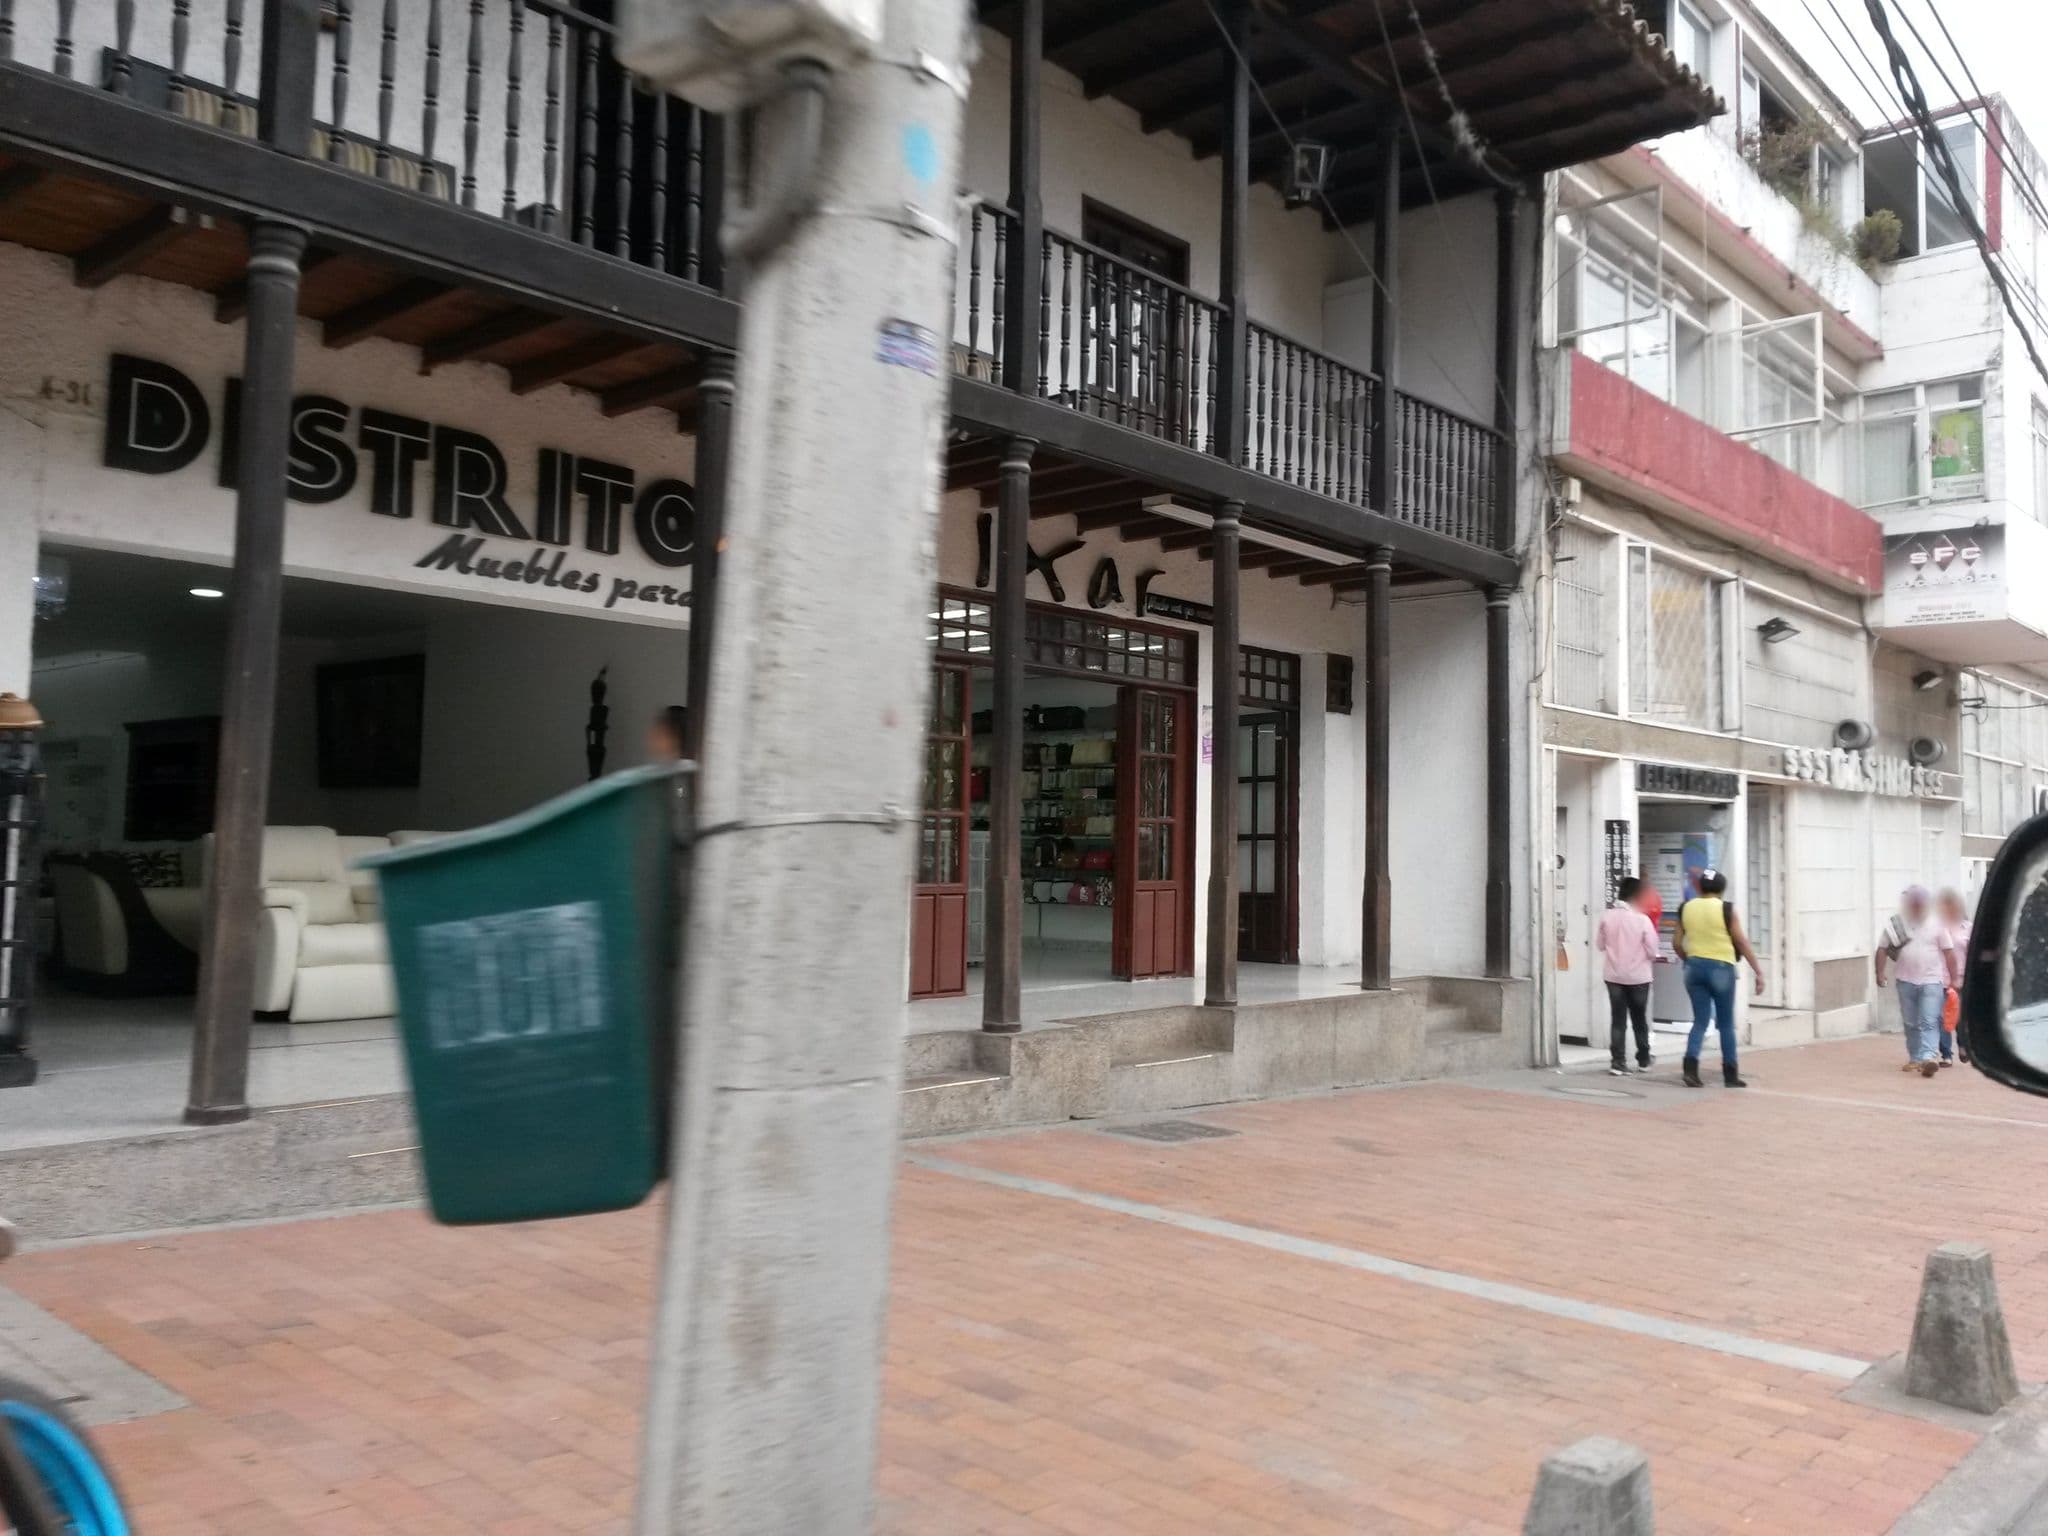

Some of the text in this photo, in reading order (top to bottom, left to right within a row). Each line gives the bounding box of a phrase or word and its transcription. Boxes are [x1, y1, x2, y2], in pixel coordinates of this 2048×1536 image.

[104, 353, 695, 567] DISTRITO
[414, 534, 599, 593] Muebles
[1909, 546, 1981, 565] SFC
